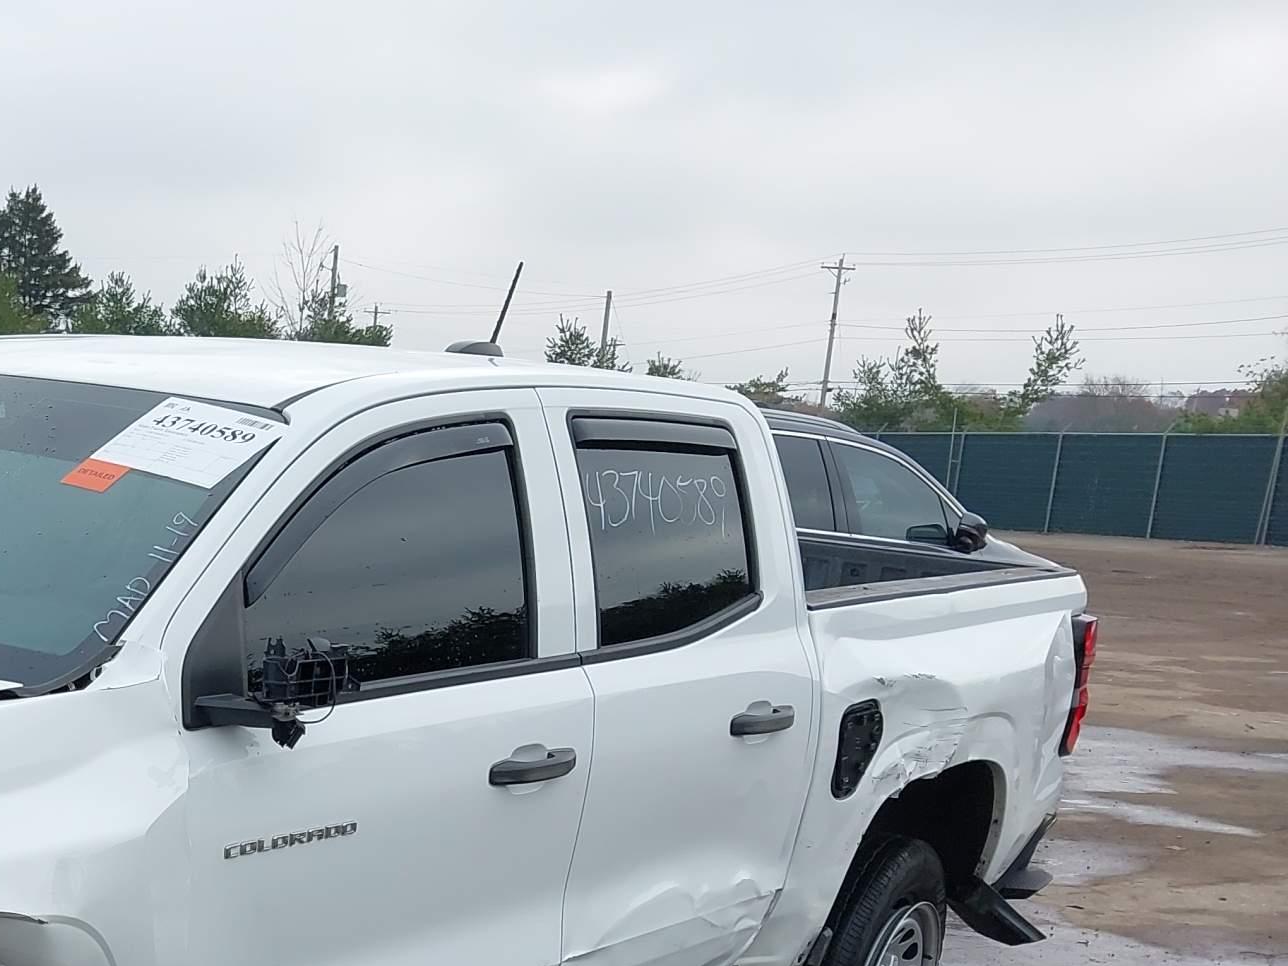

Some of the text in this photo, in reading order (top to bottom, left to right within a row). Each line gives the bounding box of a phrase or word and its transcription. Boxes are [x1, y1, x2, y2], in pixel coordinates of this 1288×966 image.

[152, 415, 256, 444] 43740589
[586, 470, 727, 539] 43740589
[148, 512, 199, 563] 11-19
[223, 821, 358, 859] COLORADO
